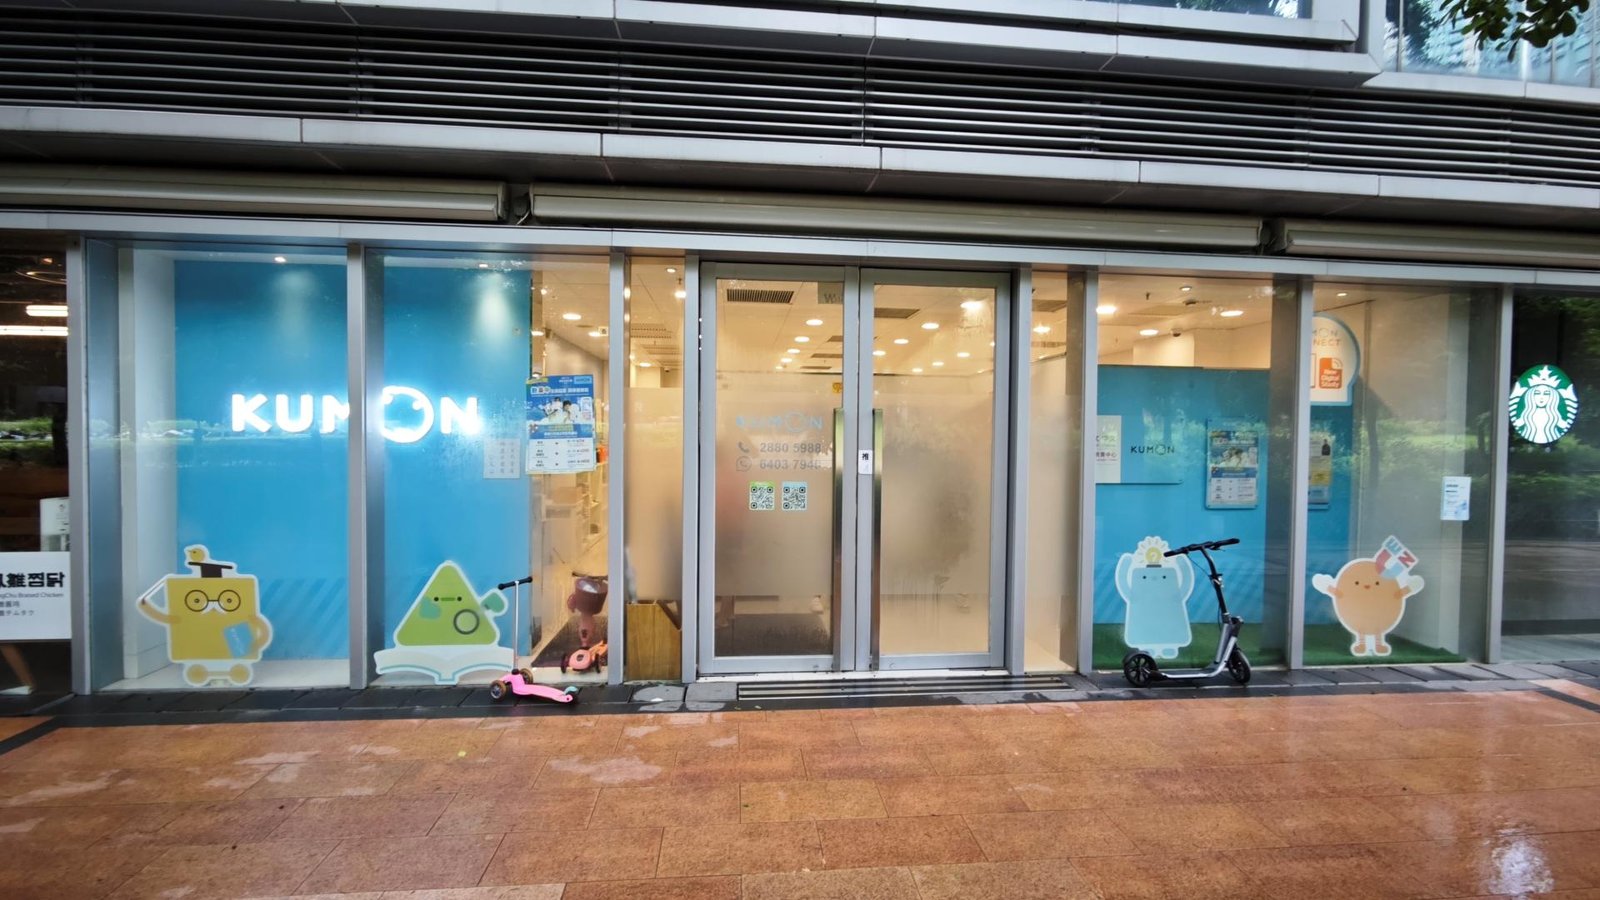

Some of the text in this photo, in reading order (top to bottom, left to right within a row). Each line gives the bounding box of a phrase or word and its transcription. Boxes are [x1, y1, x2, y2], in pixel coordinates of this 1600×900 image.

[231, 385, 480, 443] KUMON
[760, 442, 822, 454] 2880 5988
[1130, 442, 1175, 455] KUMON
[760, 459, 789, 470] 6403
